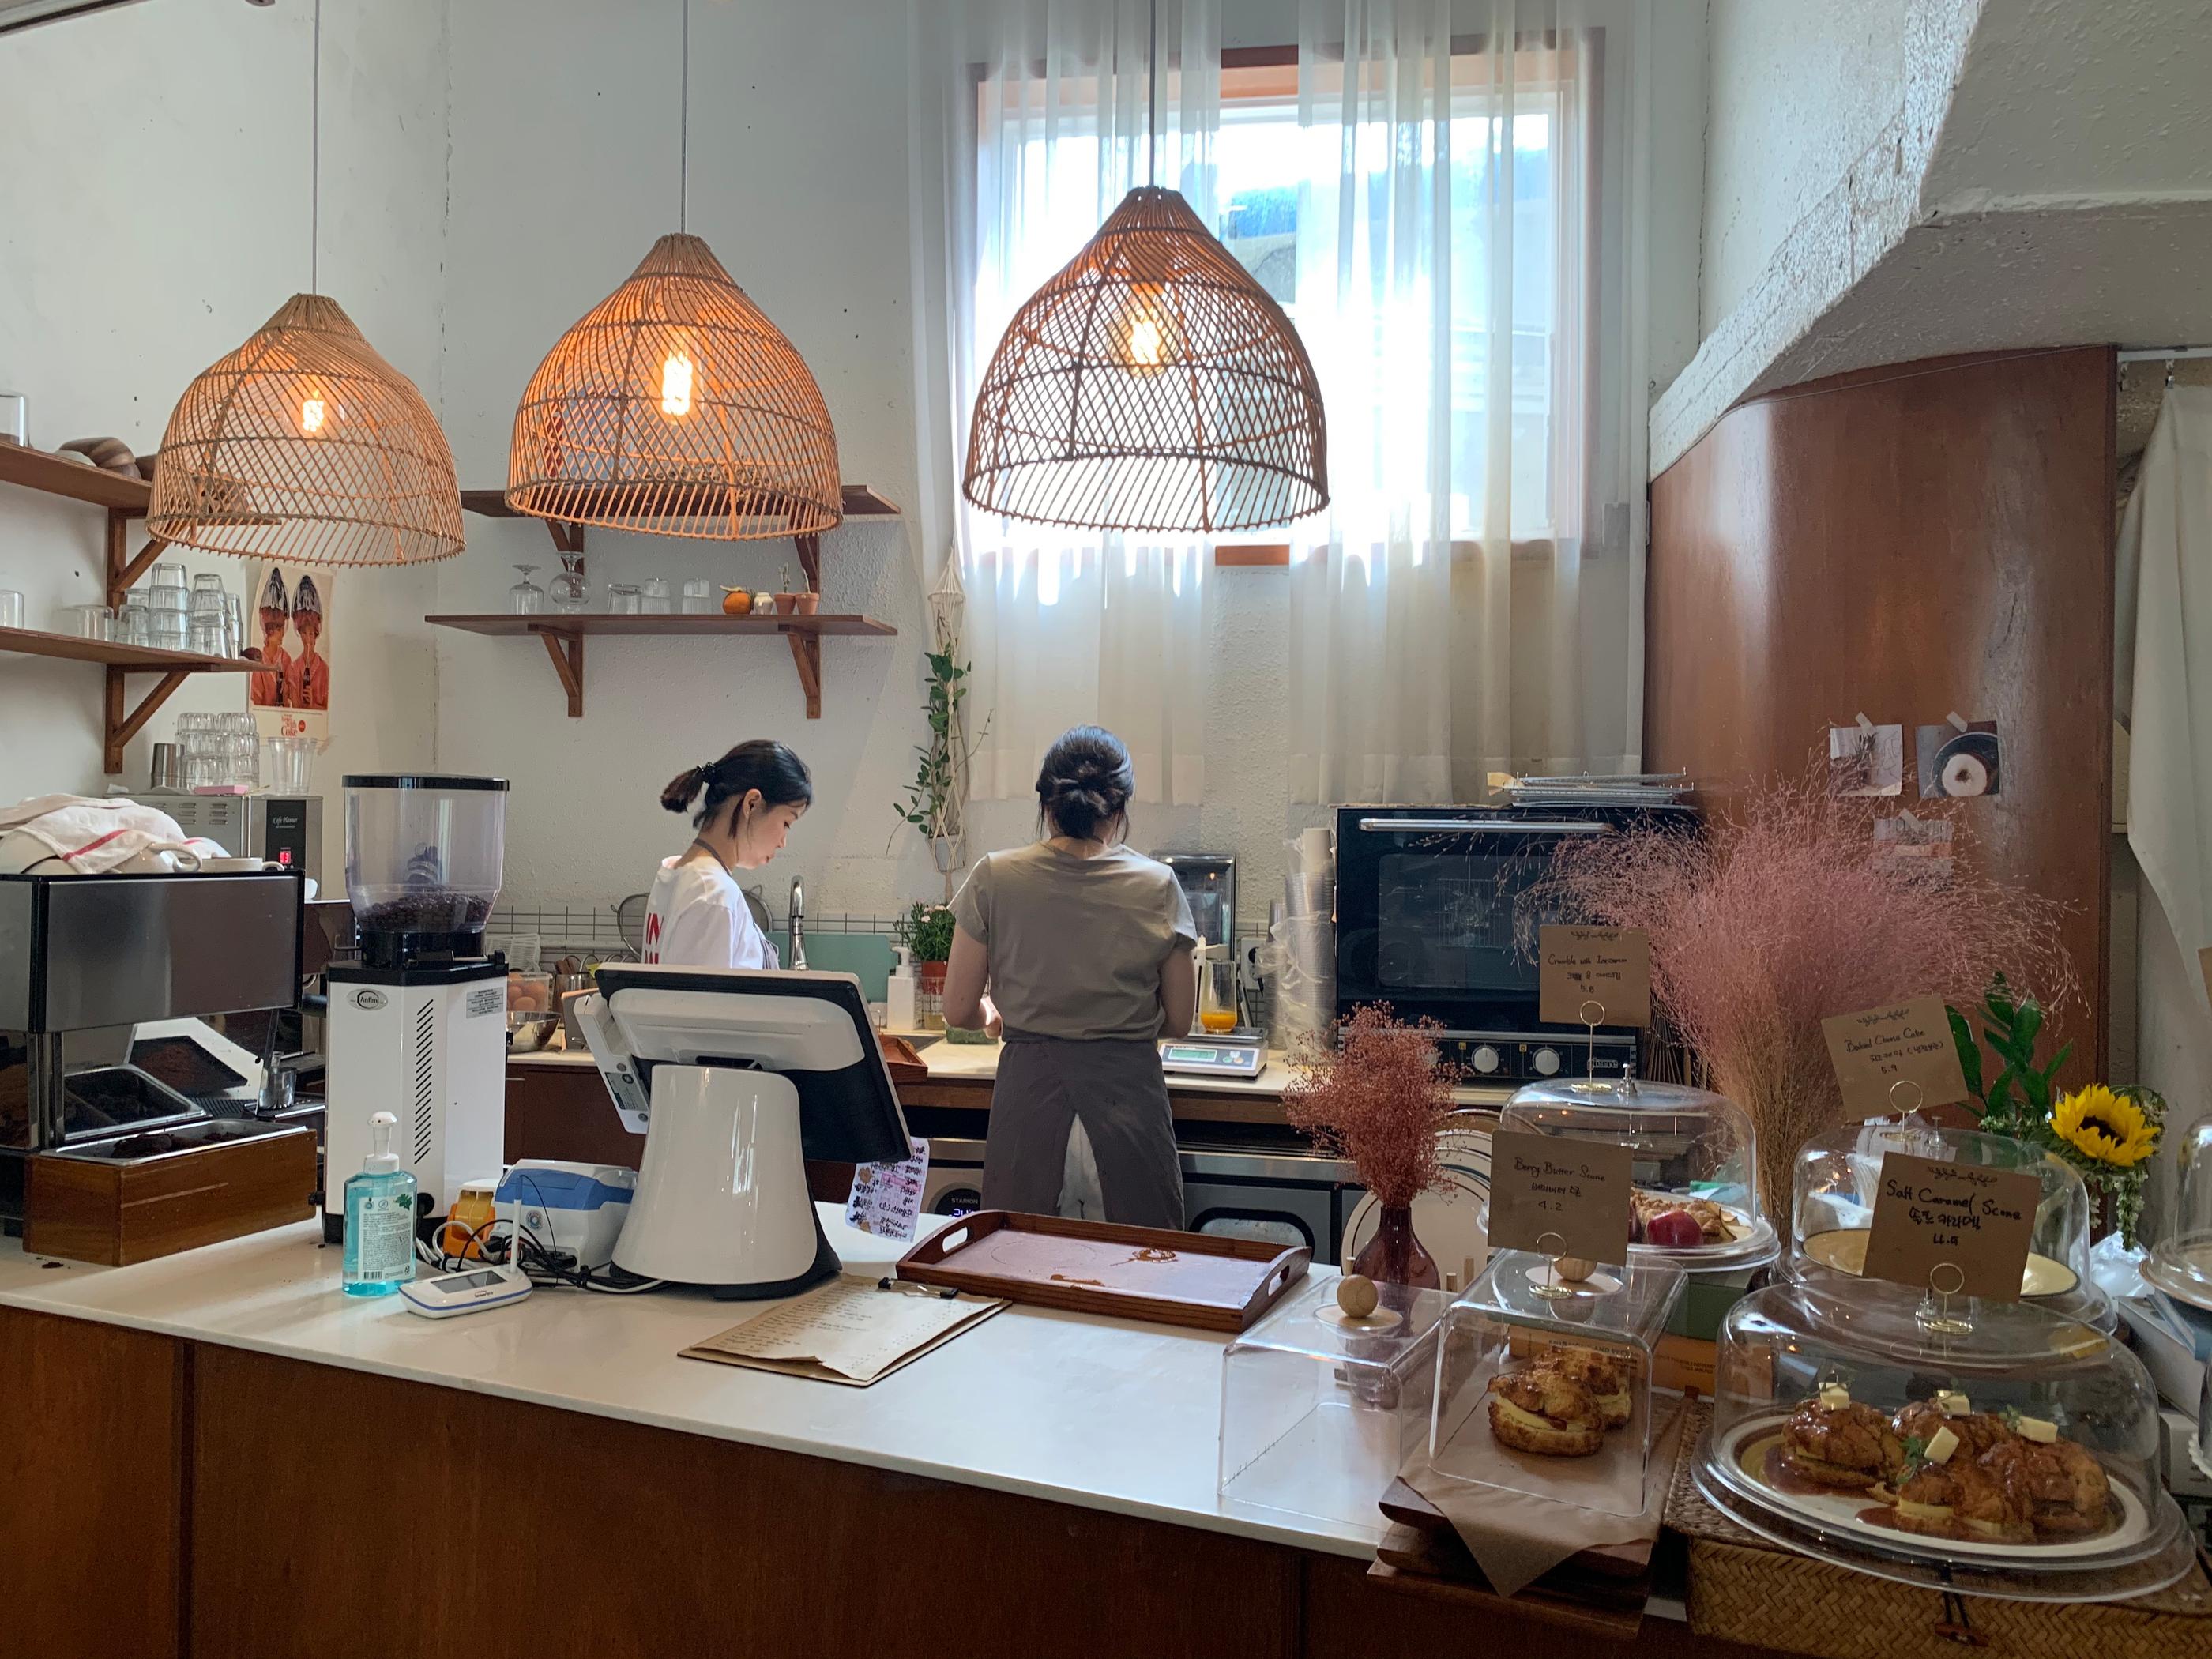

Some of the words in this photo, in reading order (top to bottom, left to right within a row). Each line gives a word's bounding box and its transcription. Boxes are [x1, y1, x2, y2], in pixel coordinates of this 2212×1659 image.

[1548, 954, 1576, 965] Crumble
[1845, 1039, 1872, 1052] Baked
[1903, 1027, 1926, 1039] Cake
[1514, 1156, 1540, 1178] Berry
[1543, 1161, 1574, 1175] Butter
[1580, 1164, 1605, 1182] Scone
[1538, 1200, 1563, 1211] 4.2
[1887, 1179, 1913, 1201] Salt
[1918, 1187, 1975, 1215] Caramel
[1981, 1199, 2022, 1220] Scone
[1938, 1213, 1981, 1230] 카라멜
